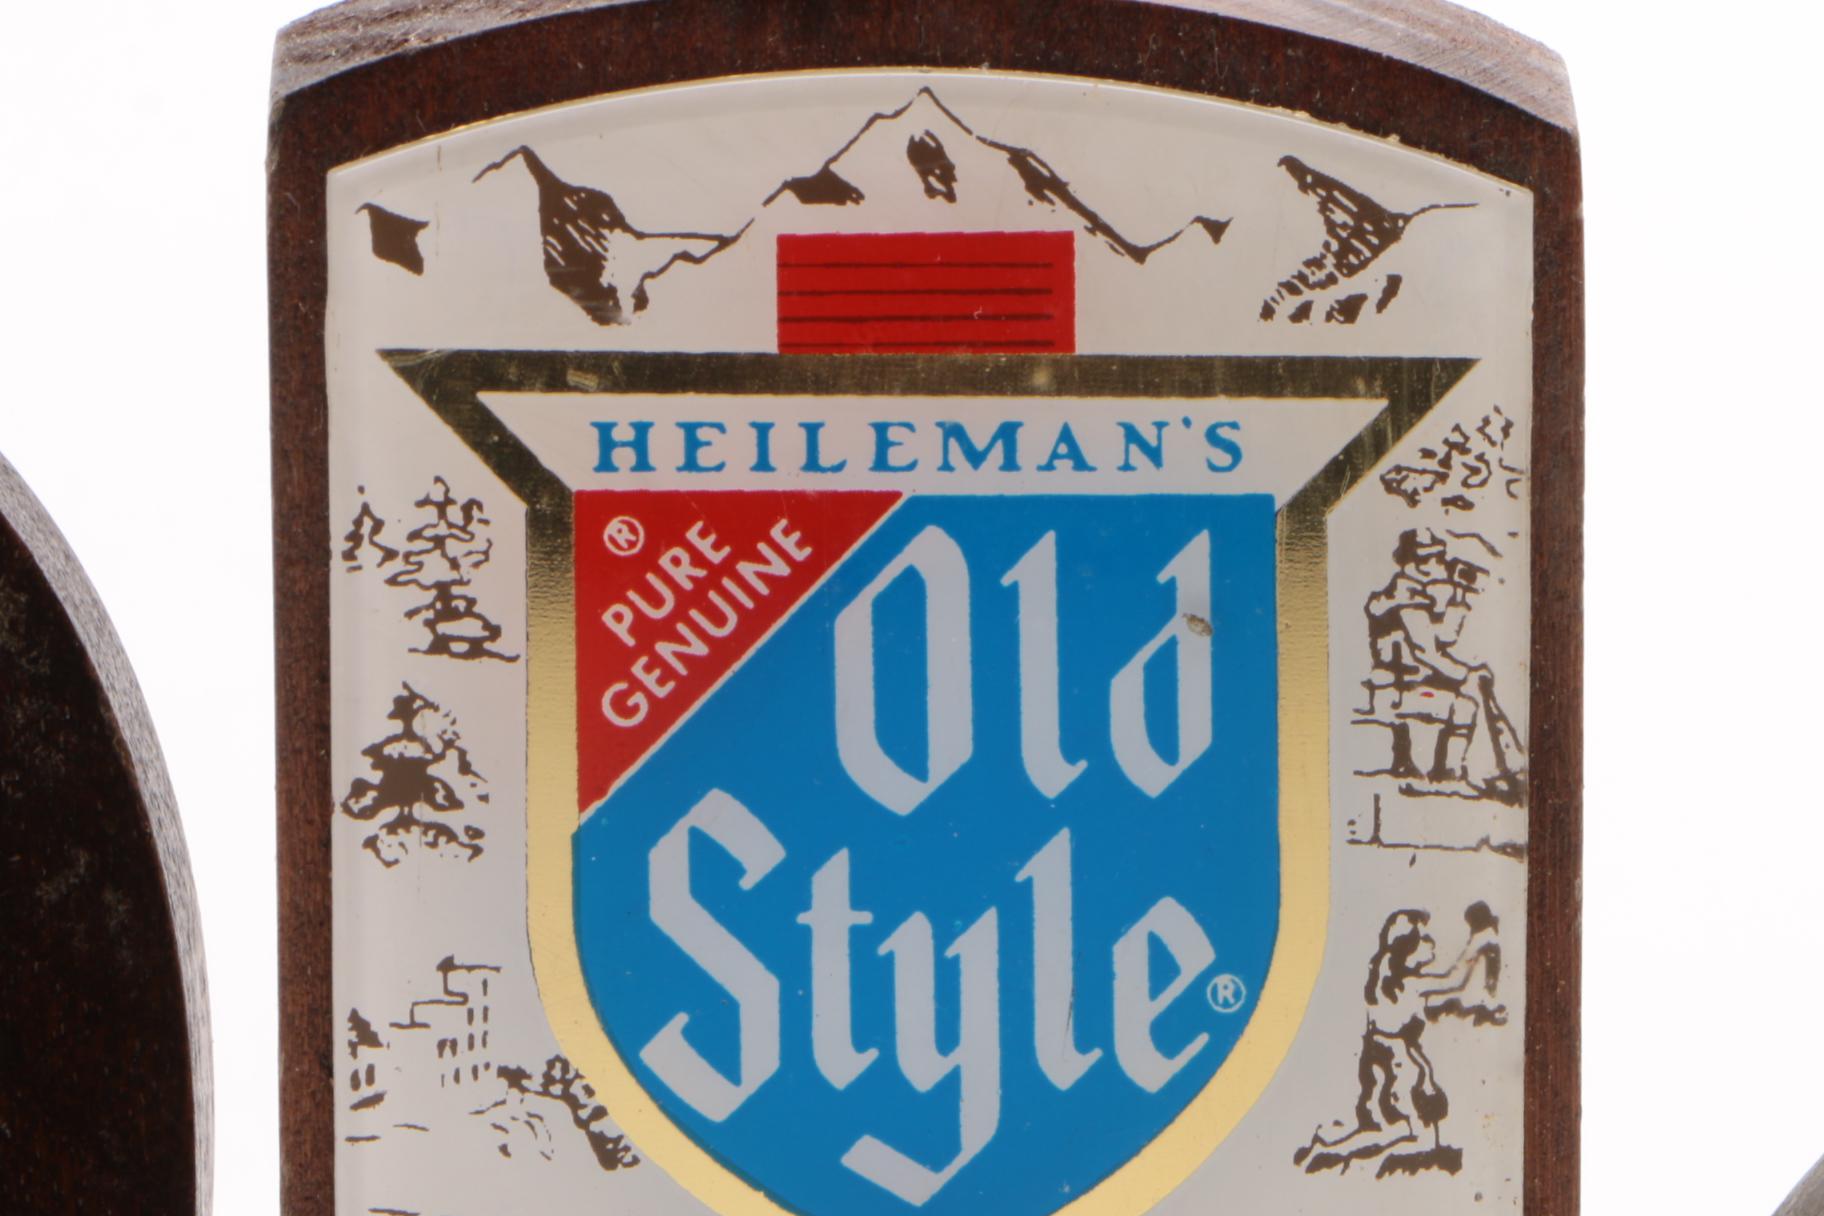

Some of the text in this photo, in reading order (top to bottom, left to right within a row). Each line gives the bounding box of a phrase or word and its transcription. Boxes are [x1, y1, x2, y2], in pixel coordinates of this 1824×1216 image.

[590, 416, 1245, 474] HEILEMAN'S
[600, 518, 732, 649] PURE
[600, 517, 814, 729] GENUINE
[832, 524, 1214, 817] Old
[638, 787, 1217, 1207] Style
